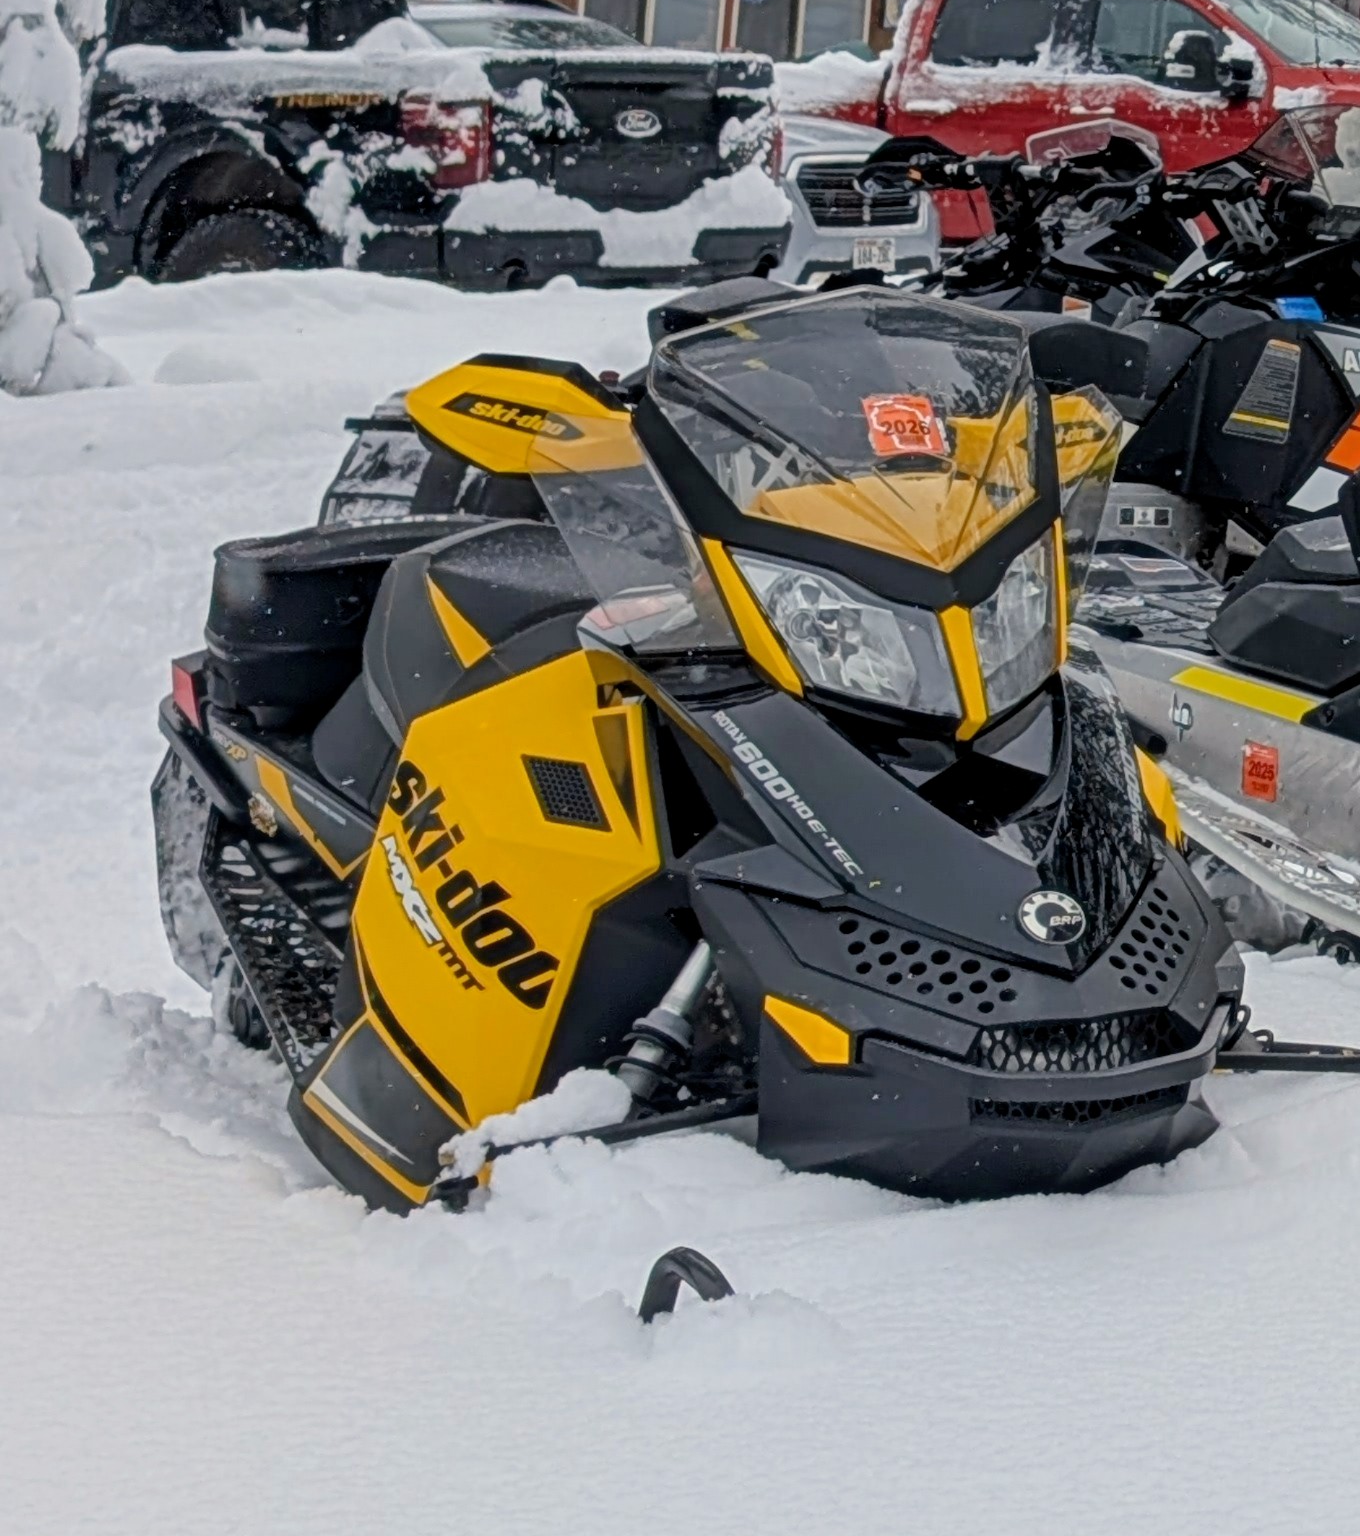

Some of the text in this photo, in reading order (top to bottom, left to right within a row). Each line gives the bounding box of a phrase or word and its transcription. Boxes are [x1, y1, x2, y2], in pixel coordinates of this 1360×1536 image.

[469, 401, 567, 436] ski-doo
[880, 419, 931, 436] 2026
[711, 710, 748, 745] ROTAX
[732, 740, 796, 801] 600
[806, 818, 865, 877] E-TEC
[387, 760, 561, 1010] ski-doo
[1049, 915, 1082, 927] BRP
